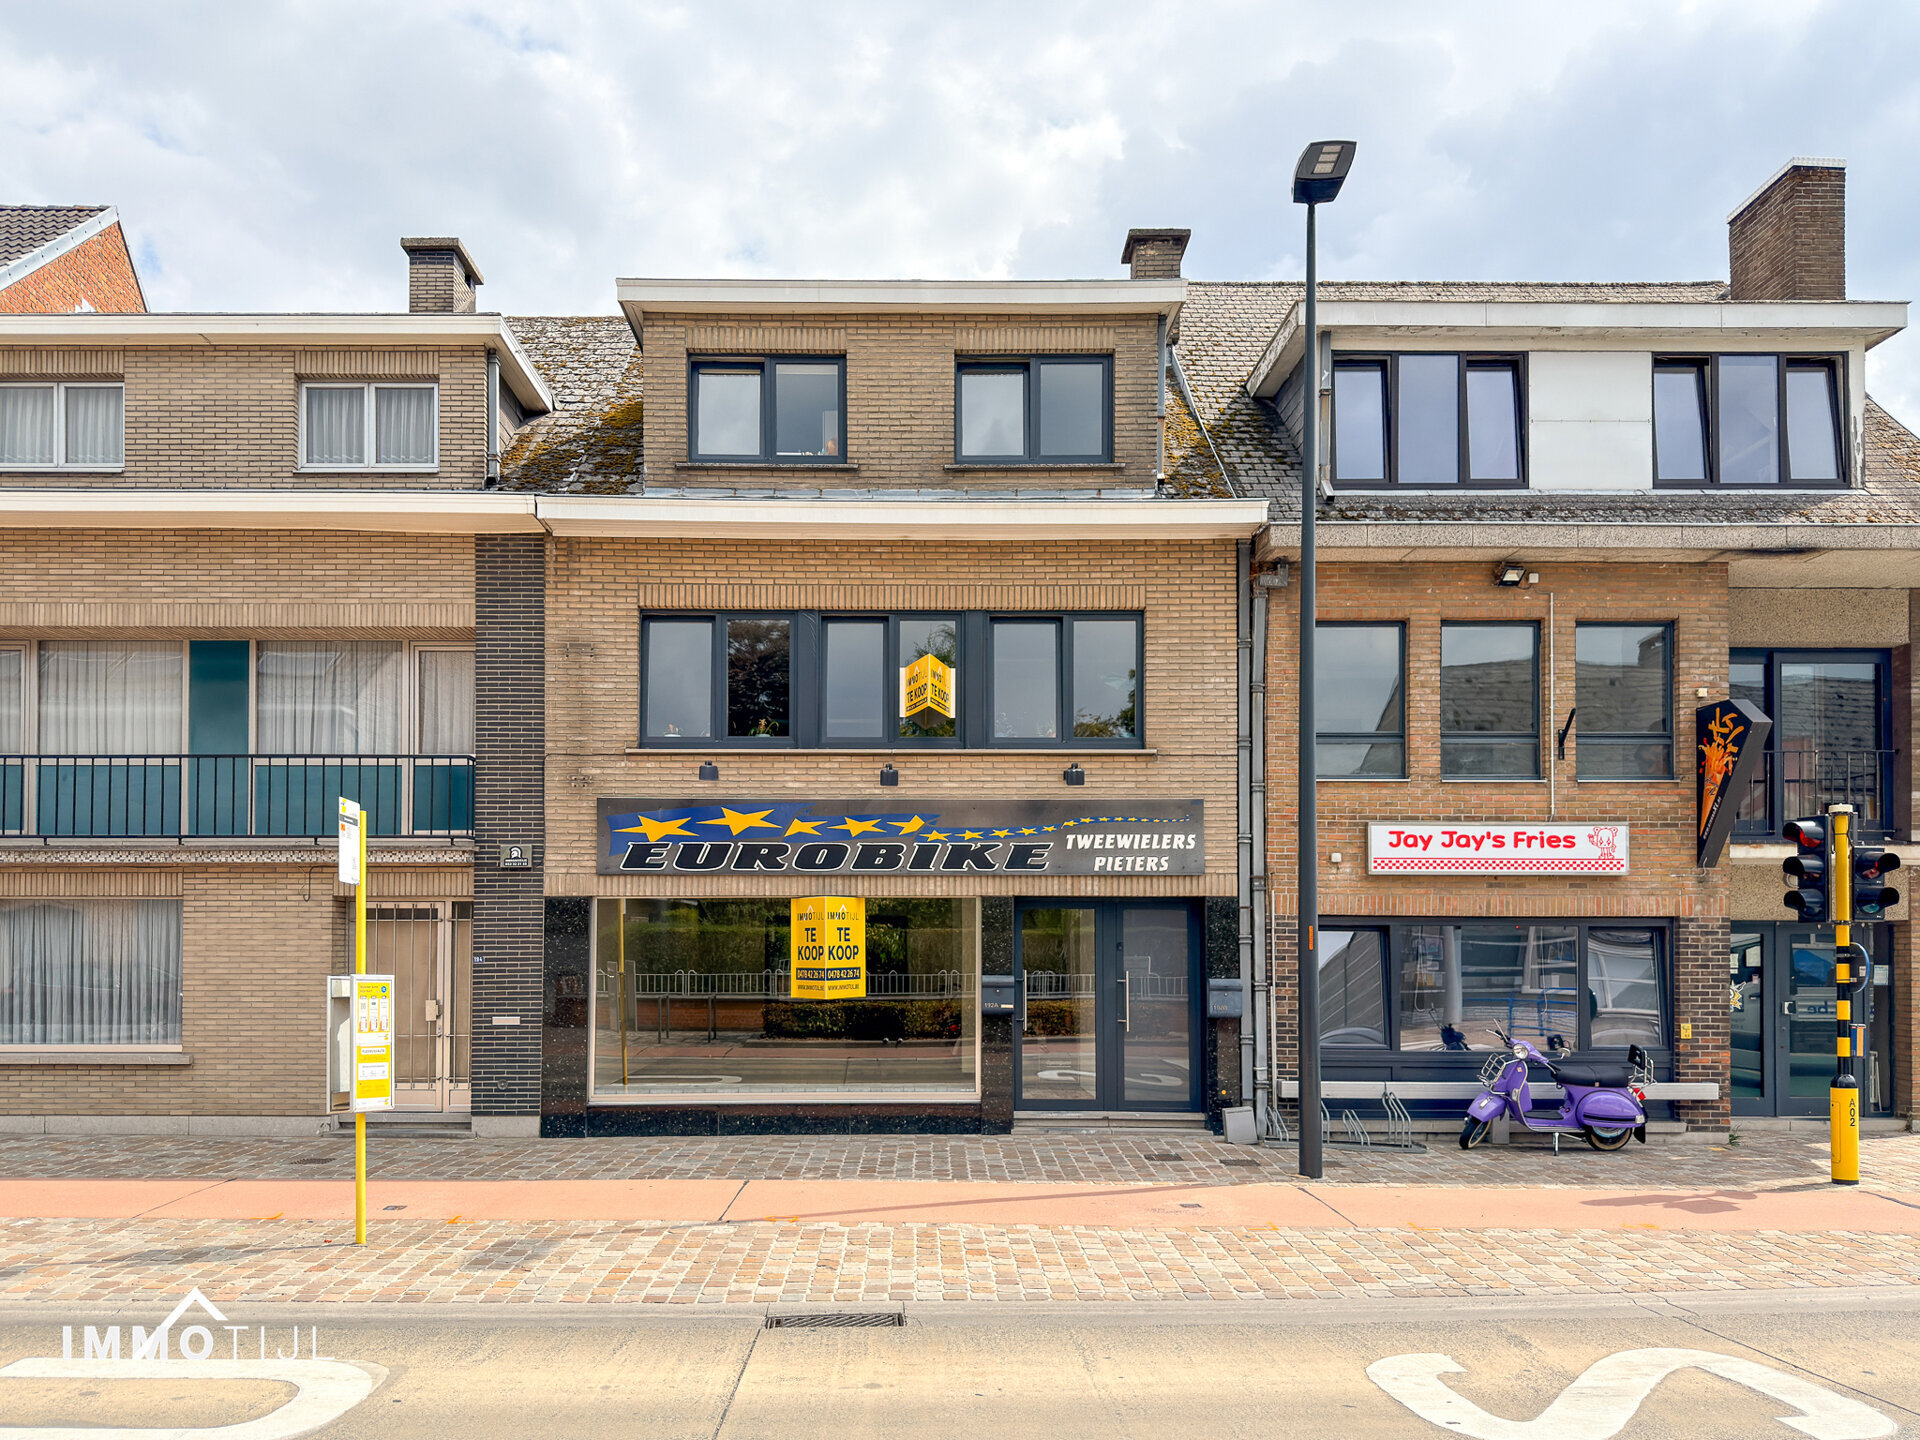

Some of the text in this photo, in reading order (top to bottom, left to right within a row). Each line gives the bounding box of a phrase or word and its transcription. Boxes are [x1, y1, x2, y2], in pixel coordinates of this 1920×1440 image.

[907, 683, 927, 703] TE KOOP
[931, 683, 937, 697] TE
[1066, 834, 1196, 850] TWEEWIELERS
[1388, 831, 1576, 851] Jay Jay's Fries
[620, 841, 1054, 872] EUROBIKE
[1094, 856, 1169, 872] PIETERS
[797, 912, 824, 921] IMMOTIJL
[828, 912, 859, 920] IMMOTIJL
[805, 928, 816, 942] TE
[837, 927, 851, 942] TE
[798, 946, 824, 960] KOOP
[828, 945, 859, 960] KOOP
[827, 968, 860, 979] 0478 42 26 74
